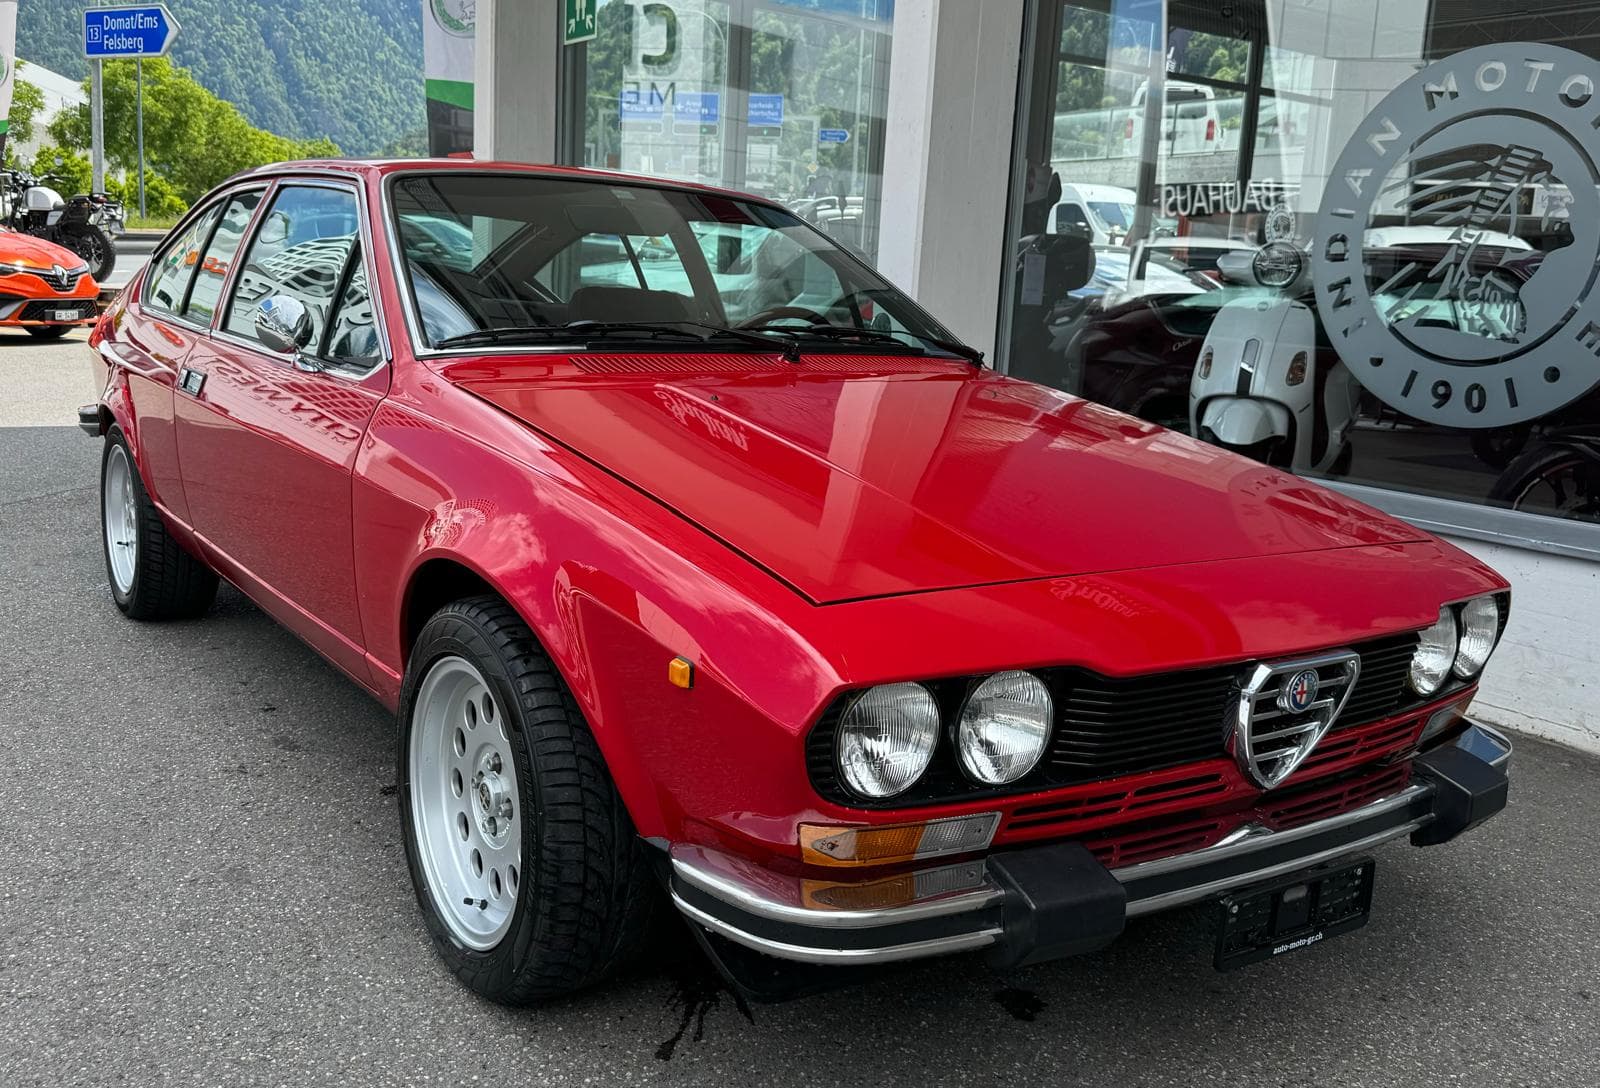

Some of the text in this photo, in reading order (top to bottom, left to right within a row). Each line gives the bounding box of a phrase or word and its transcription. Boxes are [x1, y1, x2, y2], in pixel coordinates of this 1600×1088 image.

[103, 14, 159, 31] Domat/Ems
[89, 27, 100, 41] 13
[103, 35, 144, 53] Felsberg
[1401, 368, 1519, 413] 1901
[1273, 932, 1323, 954] auto-moto-gr.ch
